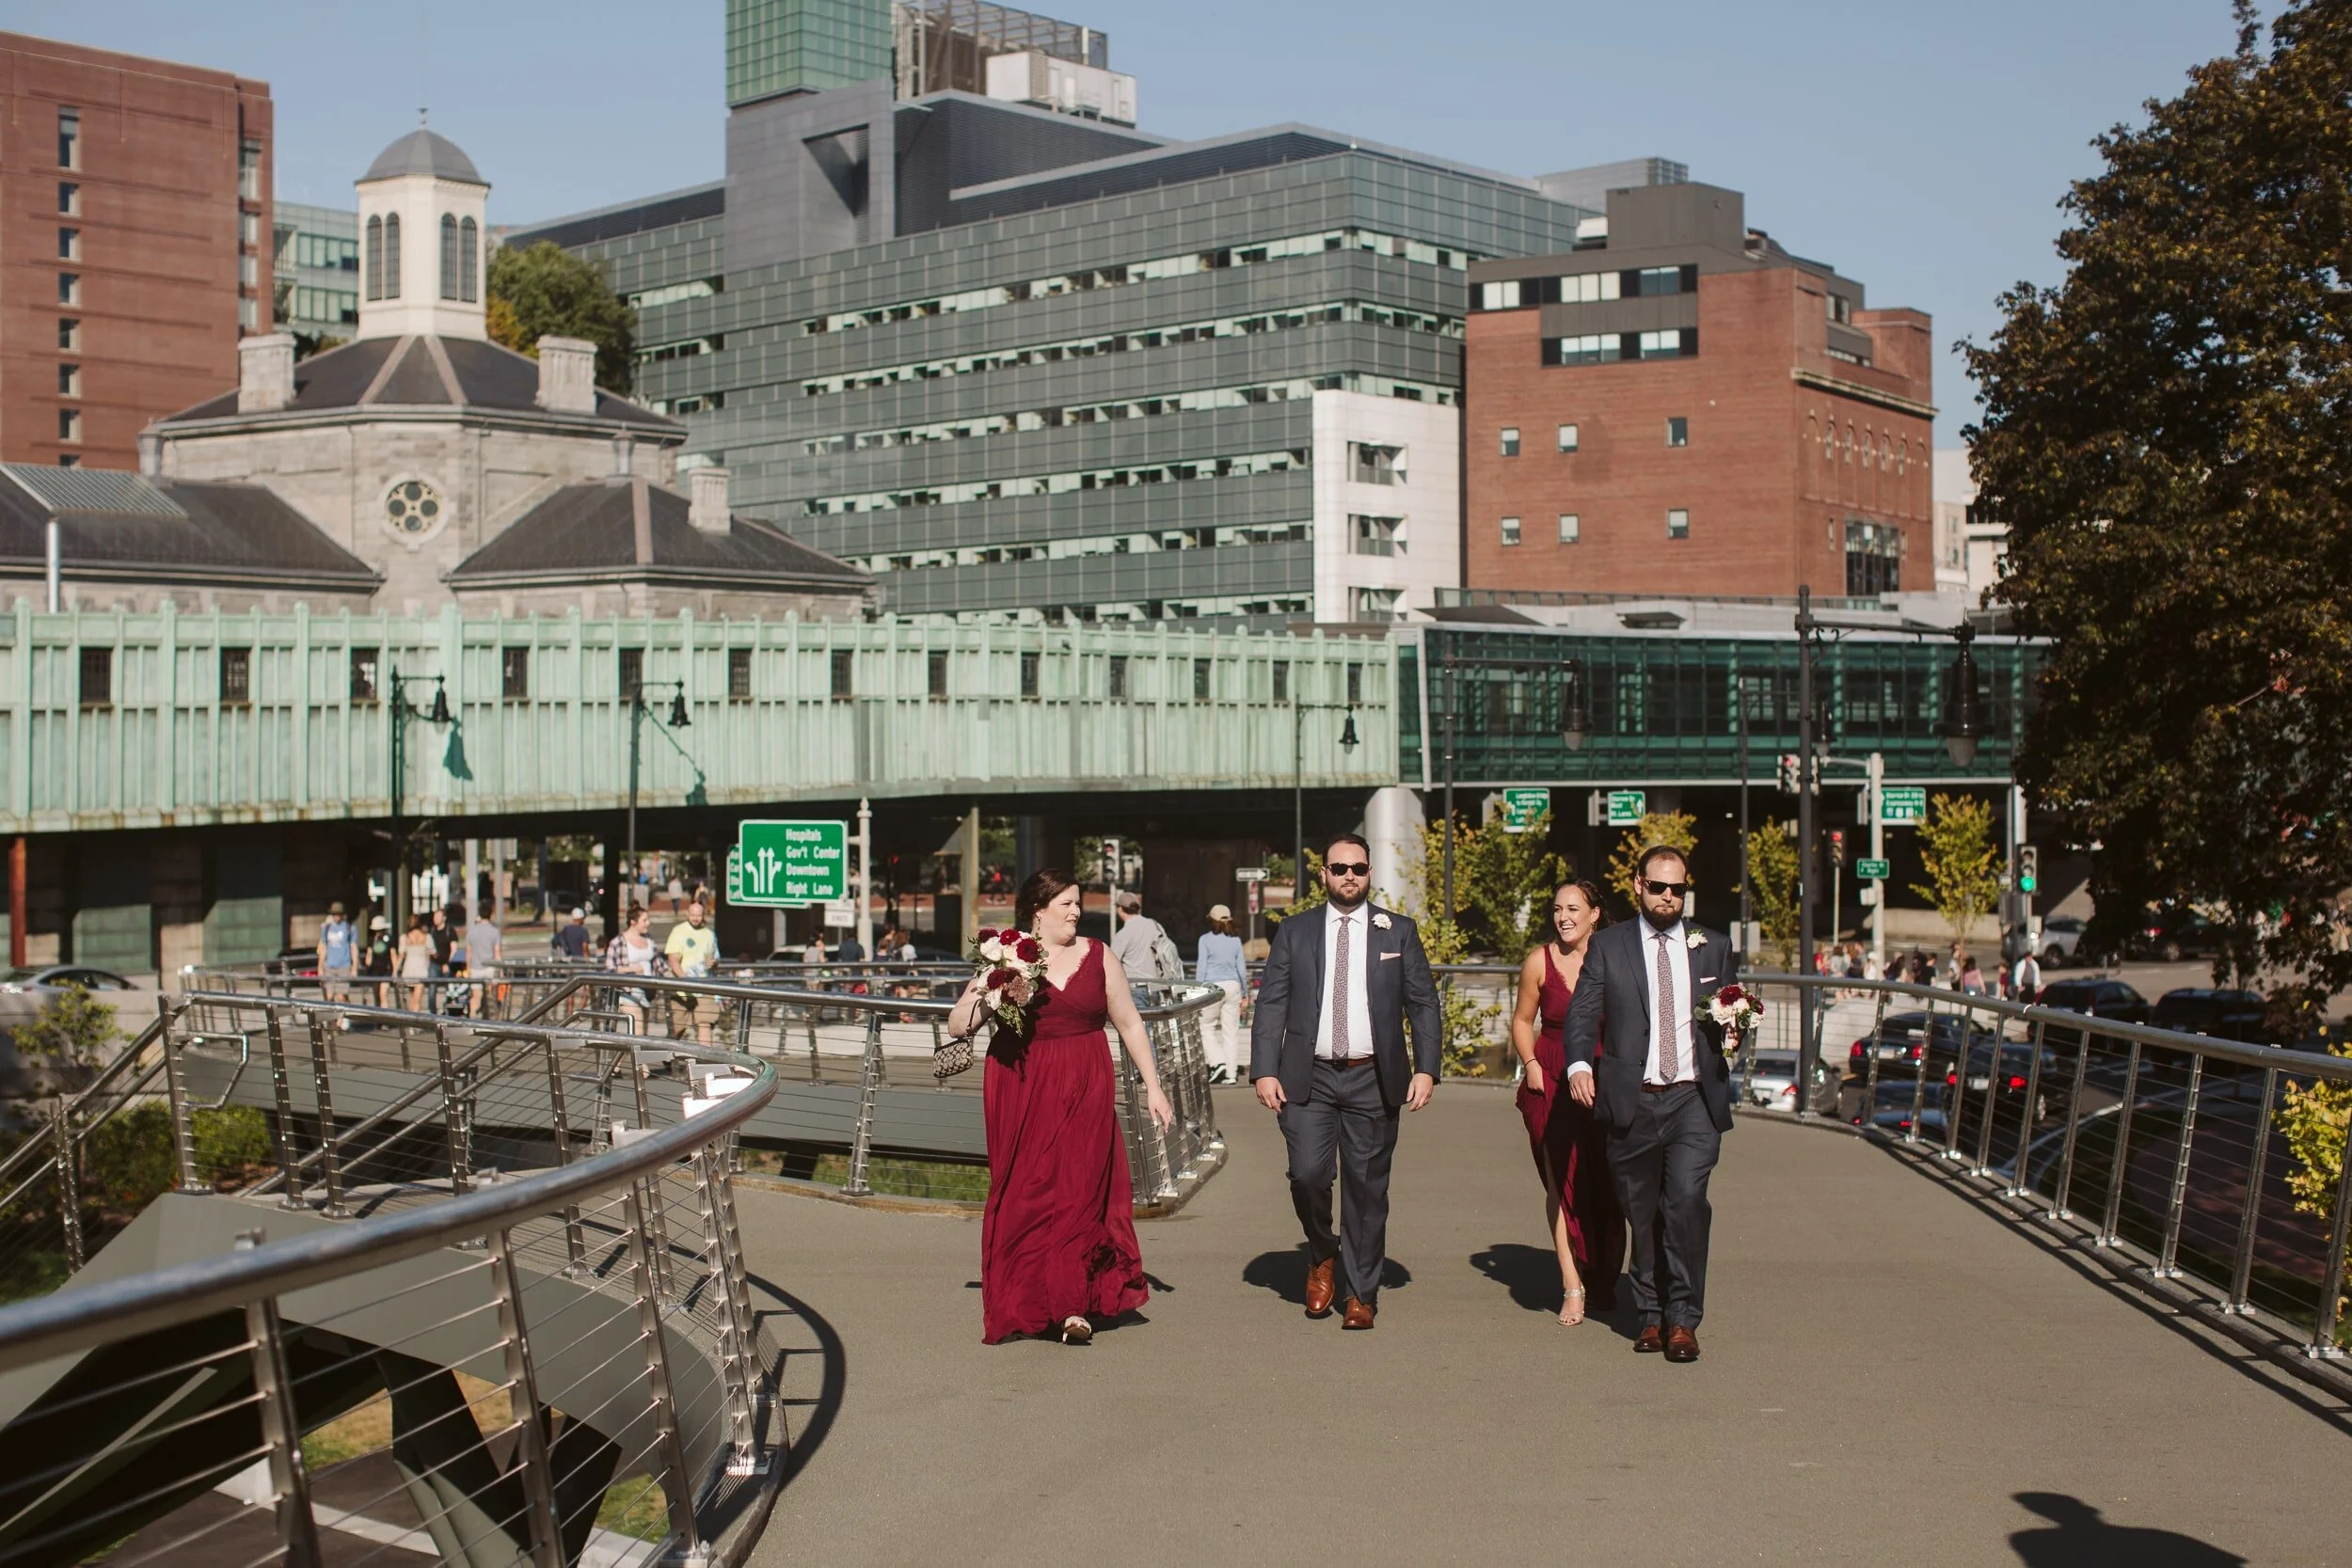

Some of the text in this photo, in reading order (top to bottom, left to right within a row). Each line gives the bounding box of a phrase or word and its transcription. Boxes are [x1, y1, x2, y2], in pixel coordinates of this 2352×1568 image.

[786, 829, 822, 844] Hospitals
[787, 846, 840, 859] Gov't Center
[787, 863, 830, 877] Downtown
[787, 881, 834, 898] Right Lane
